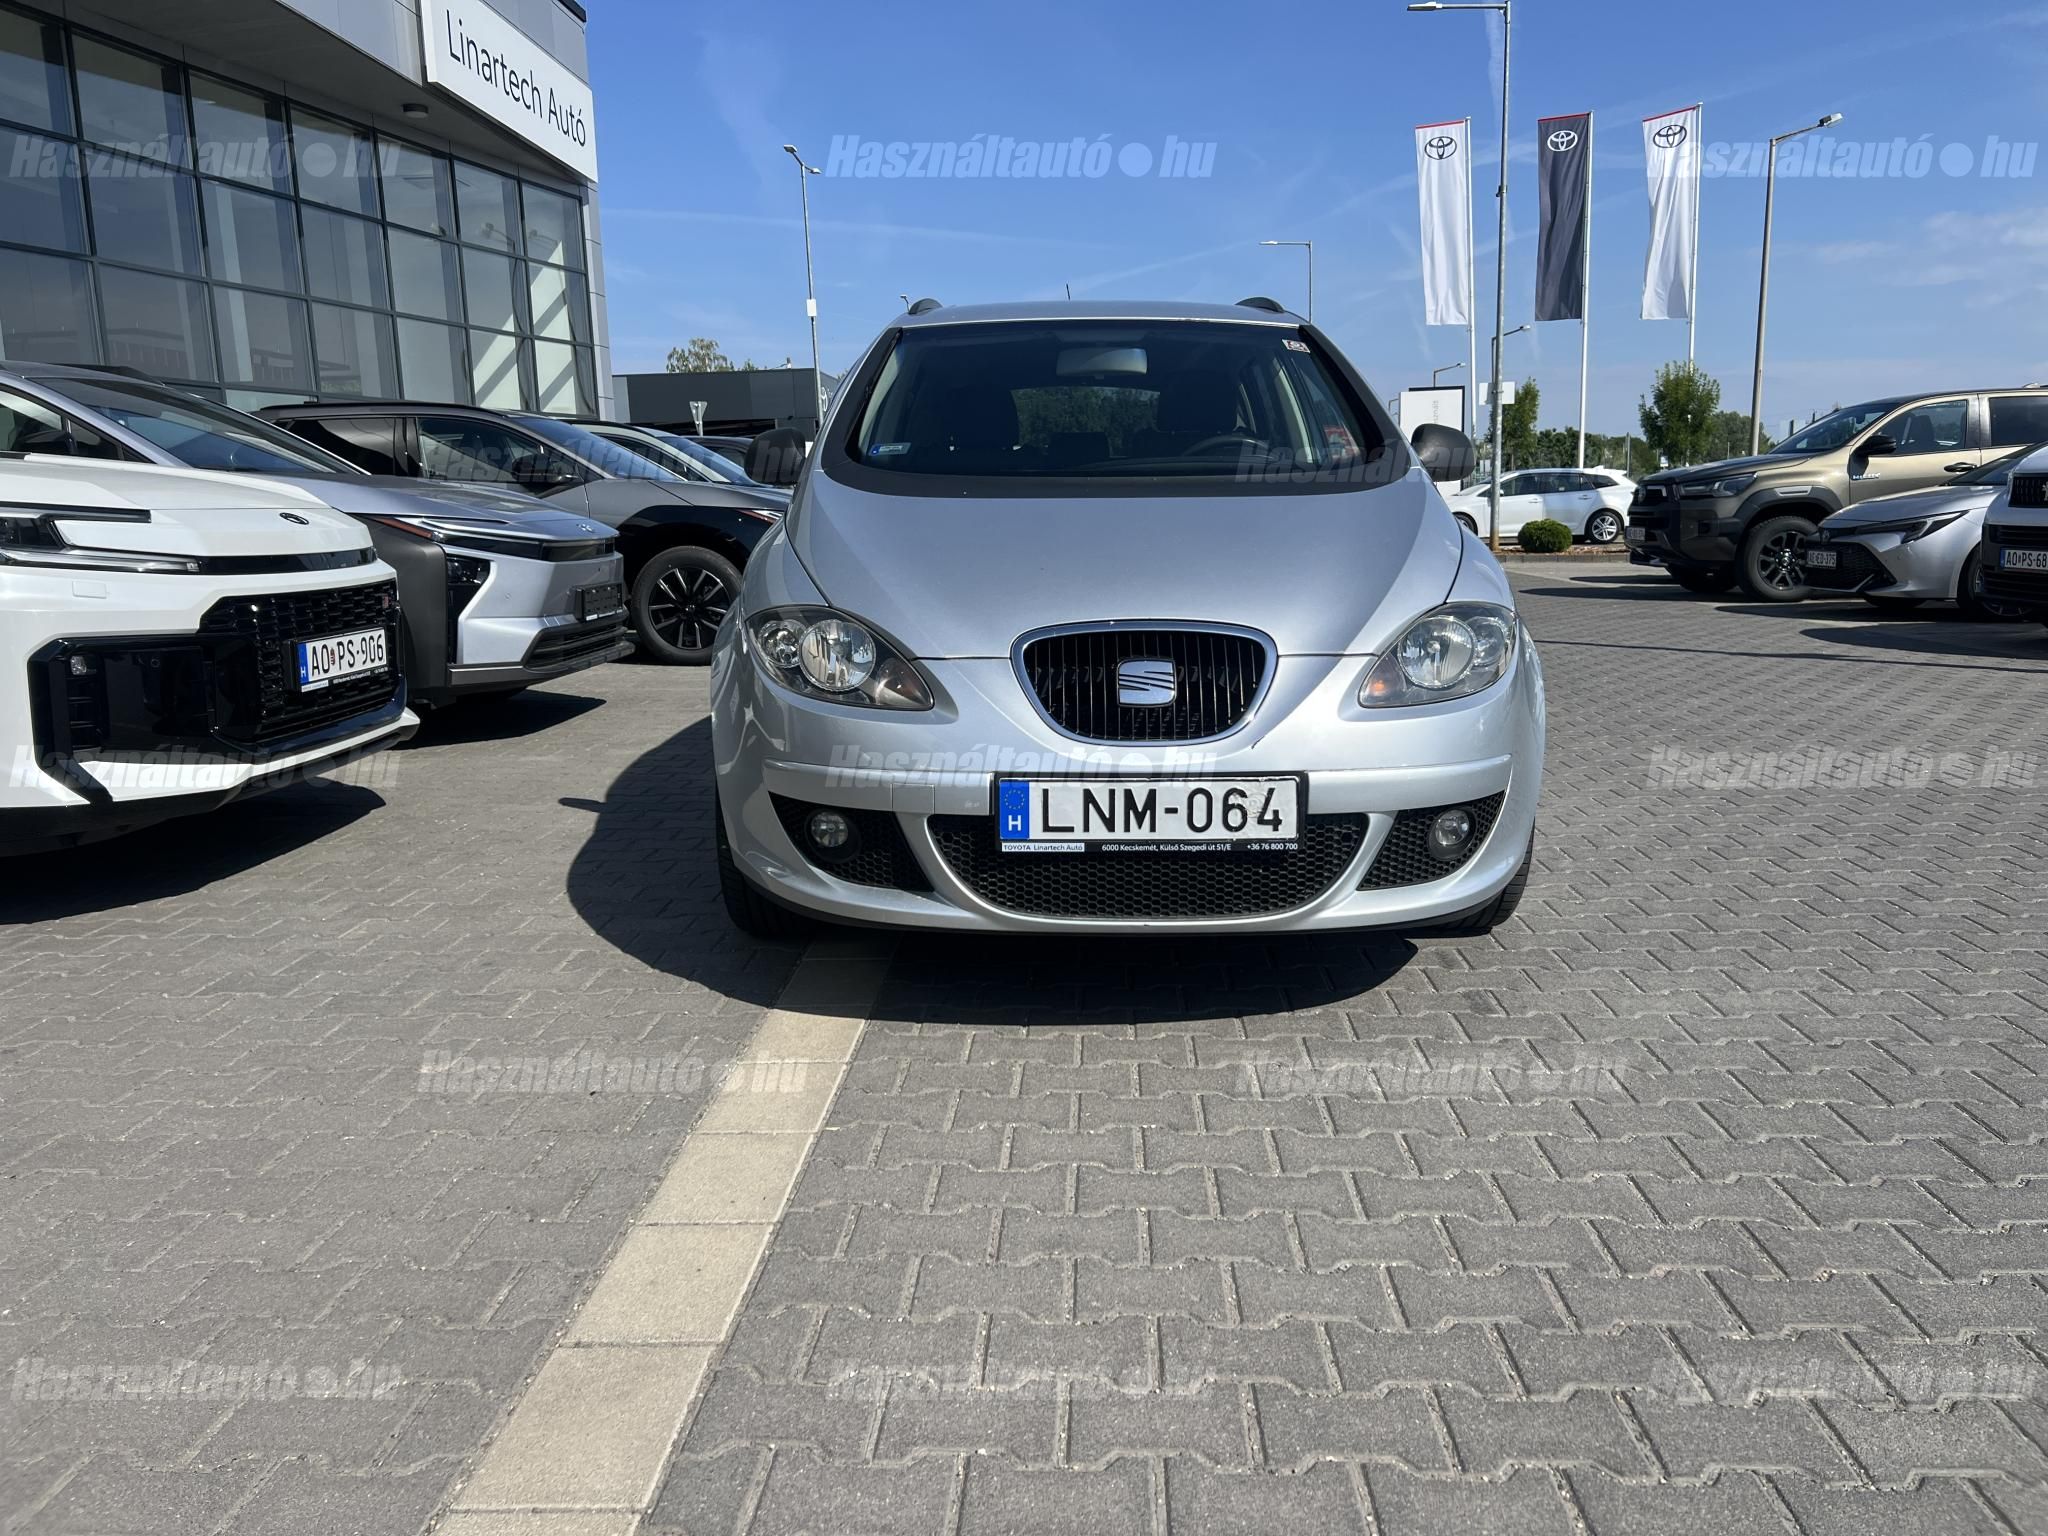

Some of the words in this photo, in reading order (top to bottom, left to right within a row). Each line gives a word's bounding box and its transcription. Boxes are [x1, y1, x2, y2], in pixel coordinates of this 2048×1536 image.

[446, 9, 543, 118] Linartech
[549, 87, 586, 147] Autó
[300, 667, 307, 677] H
[1042, 787, 1283, 833] LNM-064
[1008, 815, 1021, 831] H
[1033, 843, 1064, 851] Linartech
[1066, 843, 1083, 851] Autó
[1180, 843, 1207, 852] Szegedi
[1207, 843, 1216, 851] út
[1216, 843, 1232, 852] 51/E
[1261, 842, 1270, 850] 76
[1270, 842, 1284, 850] 800
[1285, 842, 1298, 850] 700
